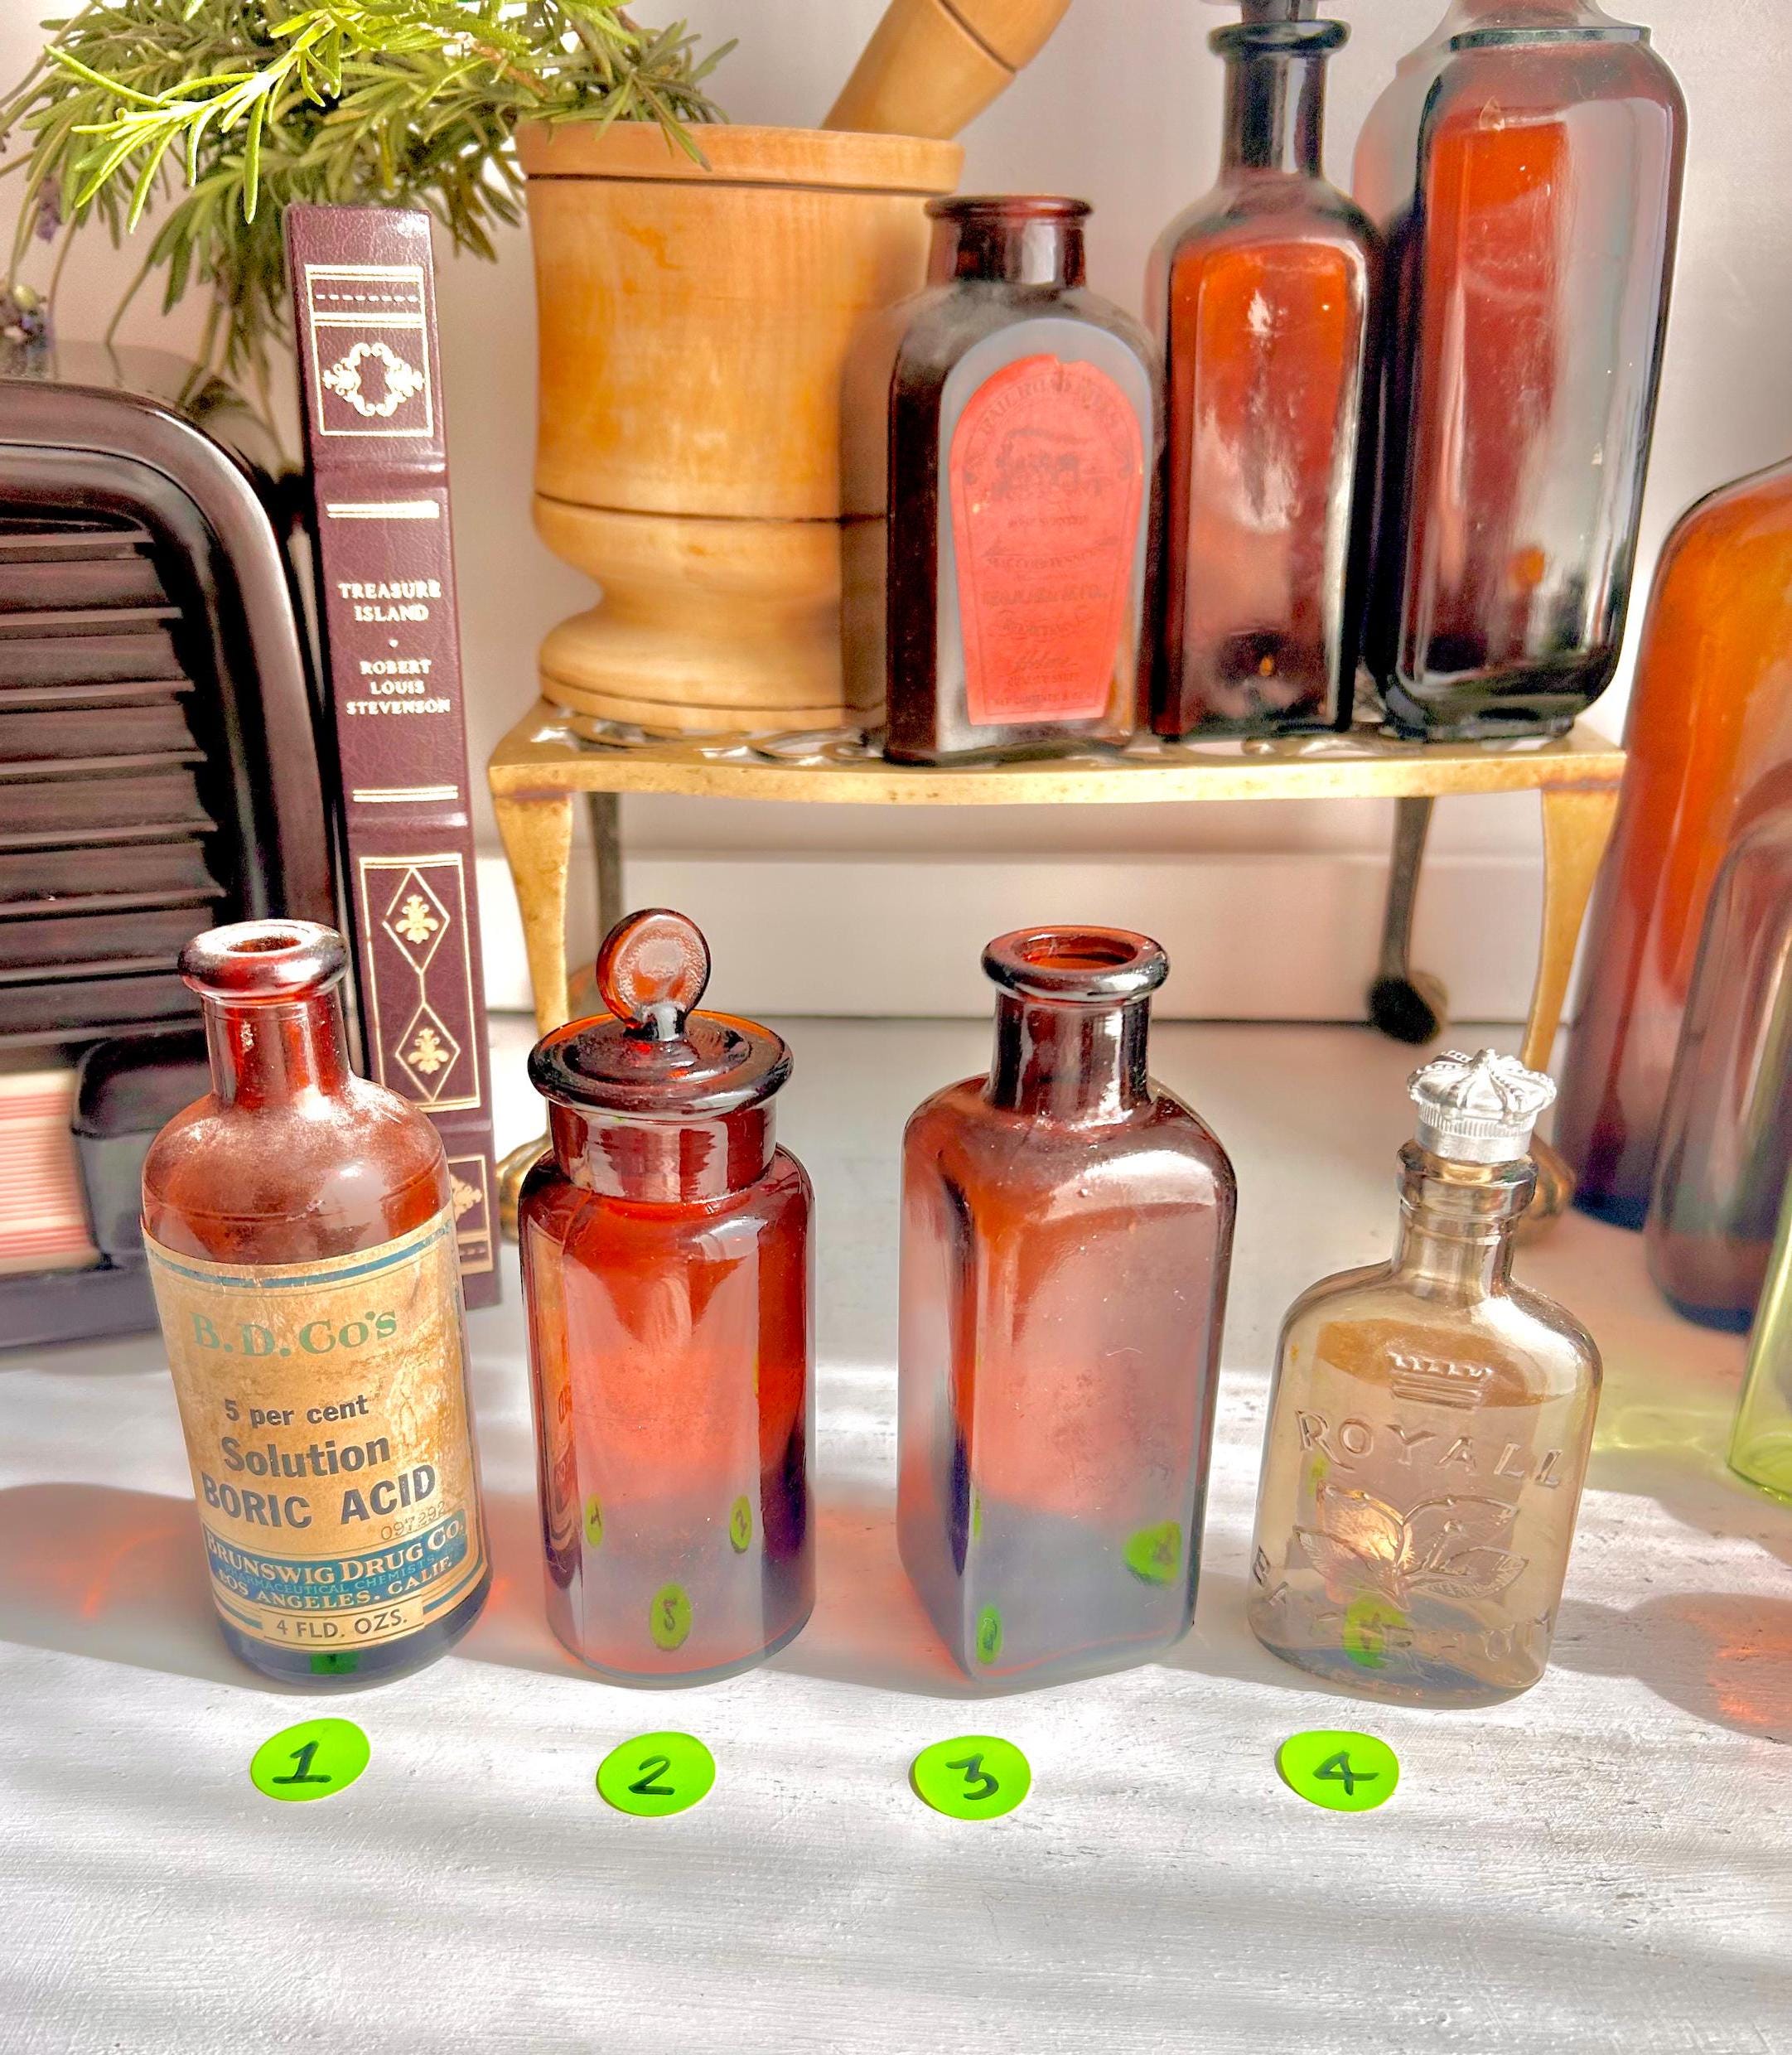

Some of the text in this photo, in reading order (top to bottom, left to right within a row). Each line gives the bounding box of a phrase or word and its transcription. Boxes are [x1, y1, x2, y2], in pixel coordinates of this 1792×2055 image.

[338, 579, 442, 599] TREASURE
[354, 603, 429, 621] ISLAND
[359, 660, 432, 675] ROBERT
[370, 680, 425, 695] LOUIS
[345, 699, 451, 715] STEVENSON
[225, 1394, 370, 1429] 5 per cent
[221, 1436, 390, 1477] Solution
[1294, 1409, 1564, 1488] ROYALL
[200, 1464, 436, 1529] BORIC ACID
[207, 1531, 336, 1586] BRUNSWIG
[338, 1542, 424, 1582] DRUG
[218, 1569, 249, 1596] LOS
[388, 1555, 453, 1595] CALIF.
[277, 1608, 408, 1638] 4 FLD. OZS.
[272, 1740, 332, 1785] 1
[627, 1754, 676, 1796] 2
[945, 1753, 1000, 1801] 3
[1312, 1749, 1380, 1796] 4
